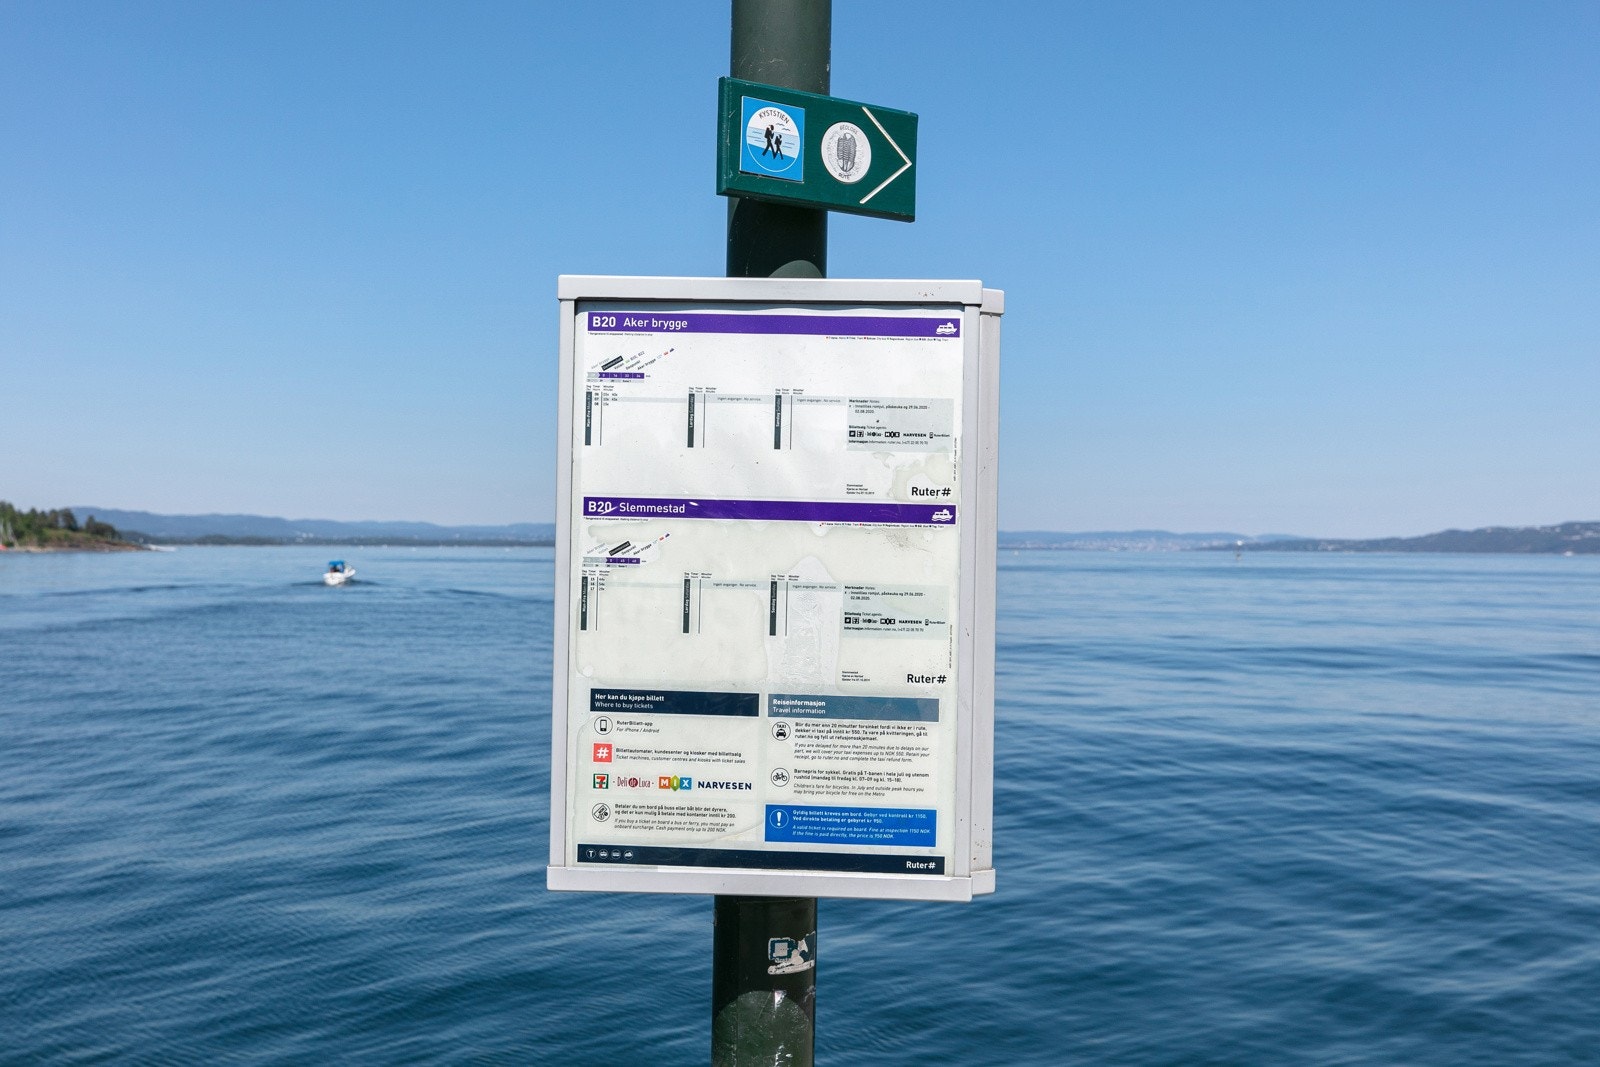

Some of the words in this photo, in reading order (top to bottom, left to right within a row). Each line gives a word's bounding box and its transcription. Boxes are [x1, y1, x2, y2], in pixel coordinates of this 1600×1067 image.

[758, 109, 790, 124] KYSTSTIEN
[592, 316, 616, 328] B20
[624, 318, 649, 327] Aker
[652, 318, 688, 330] brygge
[912, 487, 951, 496] Ruter#
[588, 501, 612, 512] B20
[620, 503, 685, 513] Slemmestad
[907, 674, 947, 684] Ruter#
[617, 776, 627, 787] Deli
[639, 778, 650, 787] Luca
[660, 777, 691, 789] MIX
[698, 781, 752, 790] NARVESEN
